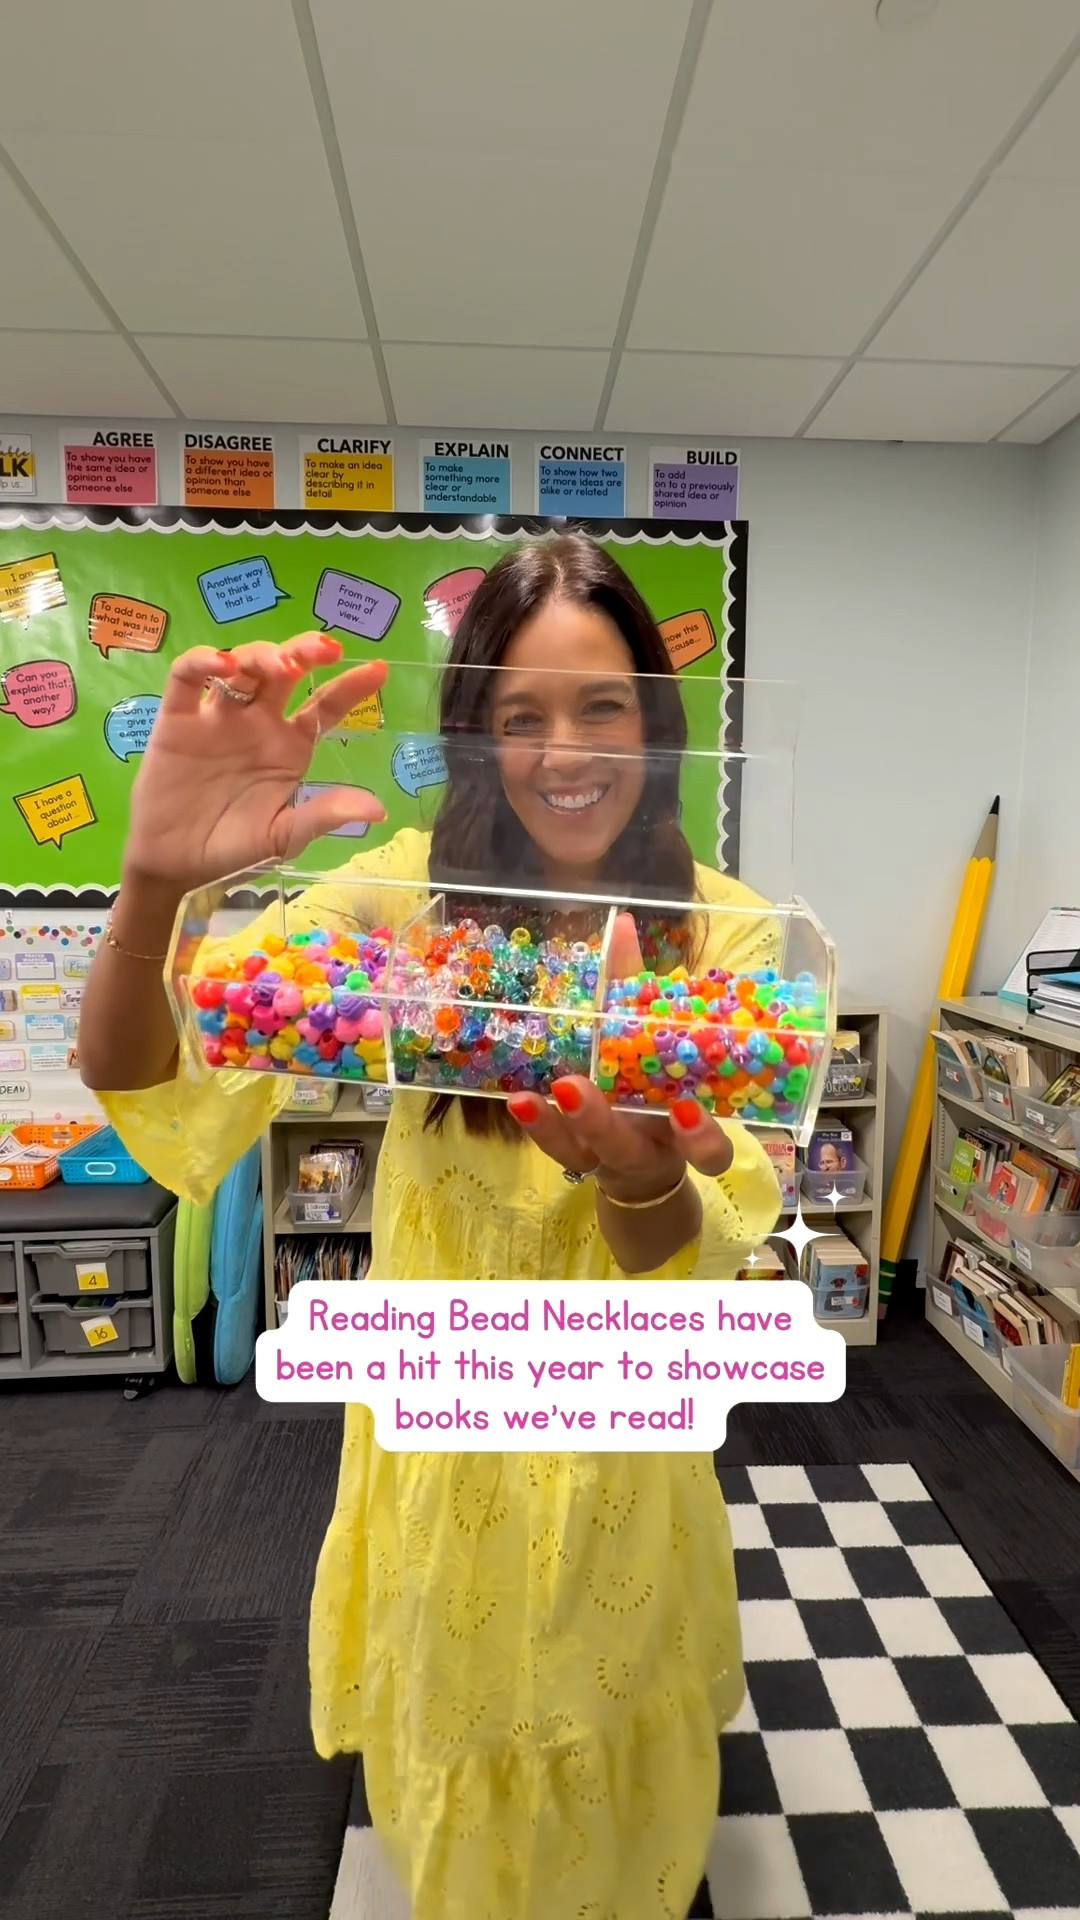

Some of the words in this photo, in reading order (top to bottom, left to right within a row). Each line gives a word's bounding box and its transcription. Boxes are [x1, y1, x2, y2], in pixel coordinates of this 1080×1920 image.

[92, 431, 154, 448] AGREE
[185, 434, 273, 451] DISAGREE
[317, 438, 392, 454] CLARIFY
[434, 442, 509, 458] EXPLAIN
[66, 451, 77, 462] To
[80, 453, 105, 463] show
[109, 454, 125, 465] you
[128, 455, 151, 464] have
[540, 446, 625, 461] CONNECT
[686, 450, 738, 465] BUILD
[67, 462, 83, 472] the
[86, 464, 111, 473] same
[114, 463, 135, 473] idea
[138, 465, 149, 473] or
[185, 455, 196, 465] To
[200, 456, 223, 466] show
[227, 458, 244, 469] you
[246, 458, 270, 468] have
[305, 459, 317, 469] To
[319, 460, 345, 470] make
[347, 462, 360, 470] an
[362, 461, 383, 470] idea
[425, 462, 436, 472] To
[438, 463, 464, 473] make
[185, 467, 192, 475] a
[195, 466, 237, 477] different
[239, 468, 260, 478] idea
[262, 470, 274, 478] or
[305, 469, 329, 479] clear
[332, 470, 344, 481] by
[540, 466, 551, 476] To
[554, 467, 577, 476] show
[579, 468, 599, 477] how
[601, 469, 618, 477] two
[655, 470, 665, 479] To
[667, 471, 686, 480] add
[67, 473, 103, 484] opinion
[105, 475, 117, 483] as
[186, 477, 221, 487] opinion
[224, 478, 246, 487] than
[425, 473, 473, 485] something
[540, 478, 551, 486] or
[553, 478, 577, 486] more
[579, 478, 604, 487] ideas
[67, 483, 112, 493] someone
[114, 484, 133, 494] else
[186, 486, 230, 496] someone
[232, 488, 251, 497] else
[305, 479, 354, 492] describing
[357, 480, 363, 489] it
[366, 481, 374, 489] in
[425, 482, 449, 492] clear
[451, 484, 462, 492] or
[540, 486, 561, 495] alike
[563, 488, 574, 496] or
[576, 488, 608, 496] related
[654, 481, 666, 489] on
[669, 480, 678, 489] to
[689, 482, 735, 493] previously
[306, 488, 333, 498] detail
[425, 492, 497, 503] understandable
[654, 489, 686, 499] shared
[687, 490, 708, 500] idea
[654, 500, 686, 509] opinion
[10, 573, 17, 582] I
[18, 571, 34, 581] am
[206, 573, 243, 591] Another
[244, 568, 264, 579] way
[216, 590, 226, 600] to
[227, 583, 250, 596] think
[251, 577, 262, 588] of
[224, 597, 245, 609] that
[338, 584, 363, 601] From
[364, 596, 382, 610] my
[100, 600, 112, 611] To
[114, 607, 134, 617] add
[135, 612, 147, 620] on
[150, 614, 161, 623] to
[336, 598, 362, 611] point
[363, 606, 374, 616] of
[96, 613, 120, 625] what
[123, 620, 141, 631] was
[142, 624, 159, 634] just
[663, 632, 682, 644] now
[683, 624, 699, 635] this
[15, 673, 38, 683] Can
[40, 671, 58, 682] you
[10, 684, 46, 696] explain
[48, 679, 67, 689] that
[23, 693, 60, 705] another
[32, 703, 56, 715] way?
[127, 719, 147, 728] give
[400, 750, 406, 760] I
[33, 800, 41, 810] I
[41, 794, 65, 807] have
[40, 800, 78, 820] question
[88, 1275, 98, 1286] 4
[94, 1328, 108, 1340] 16
